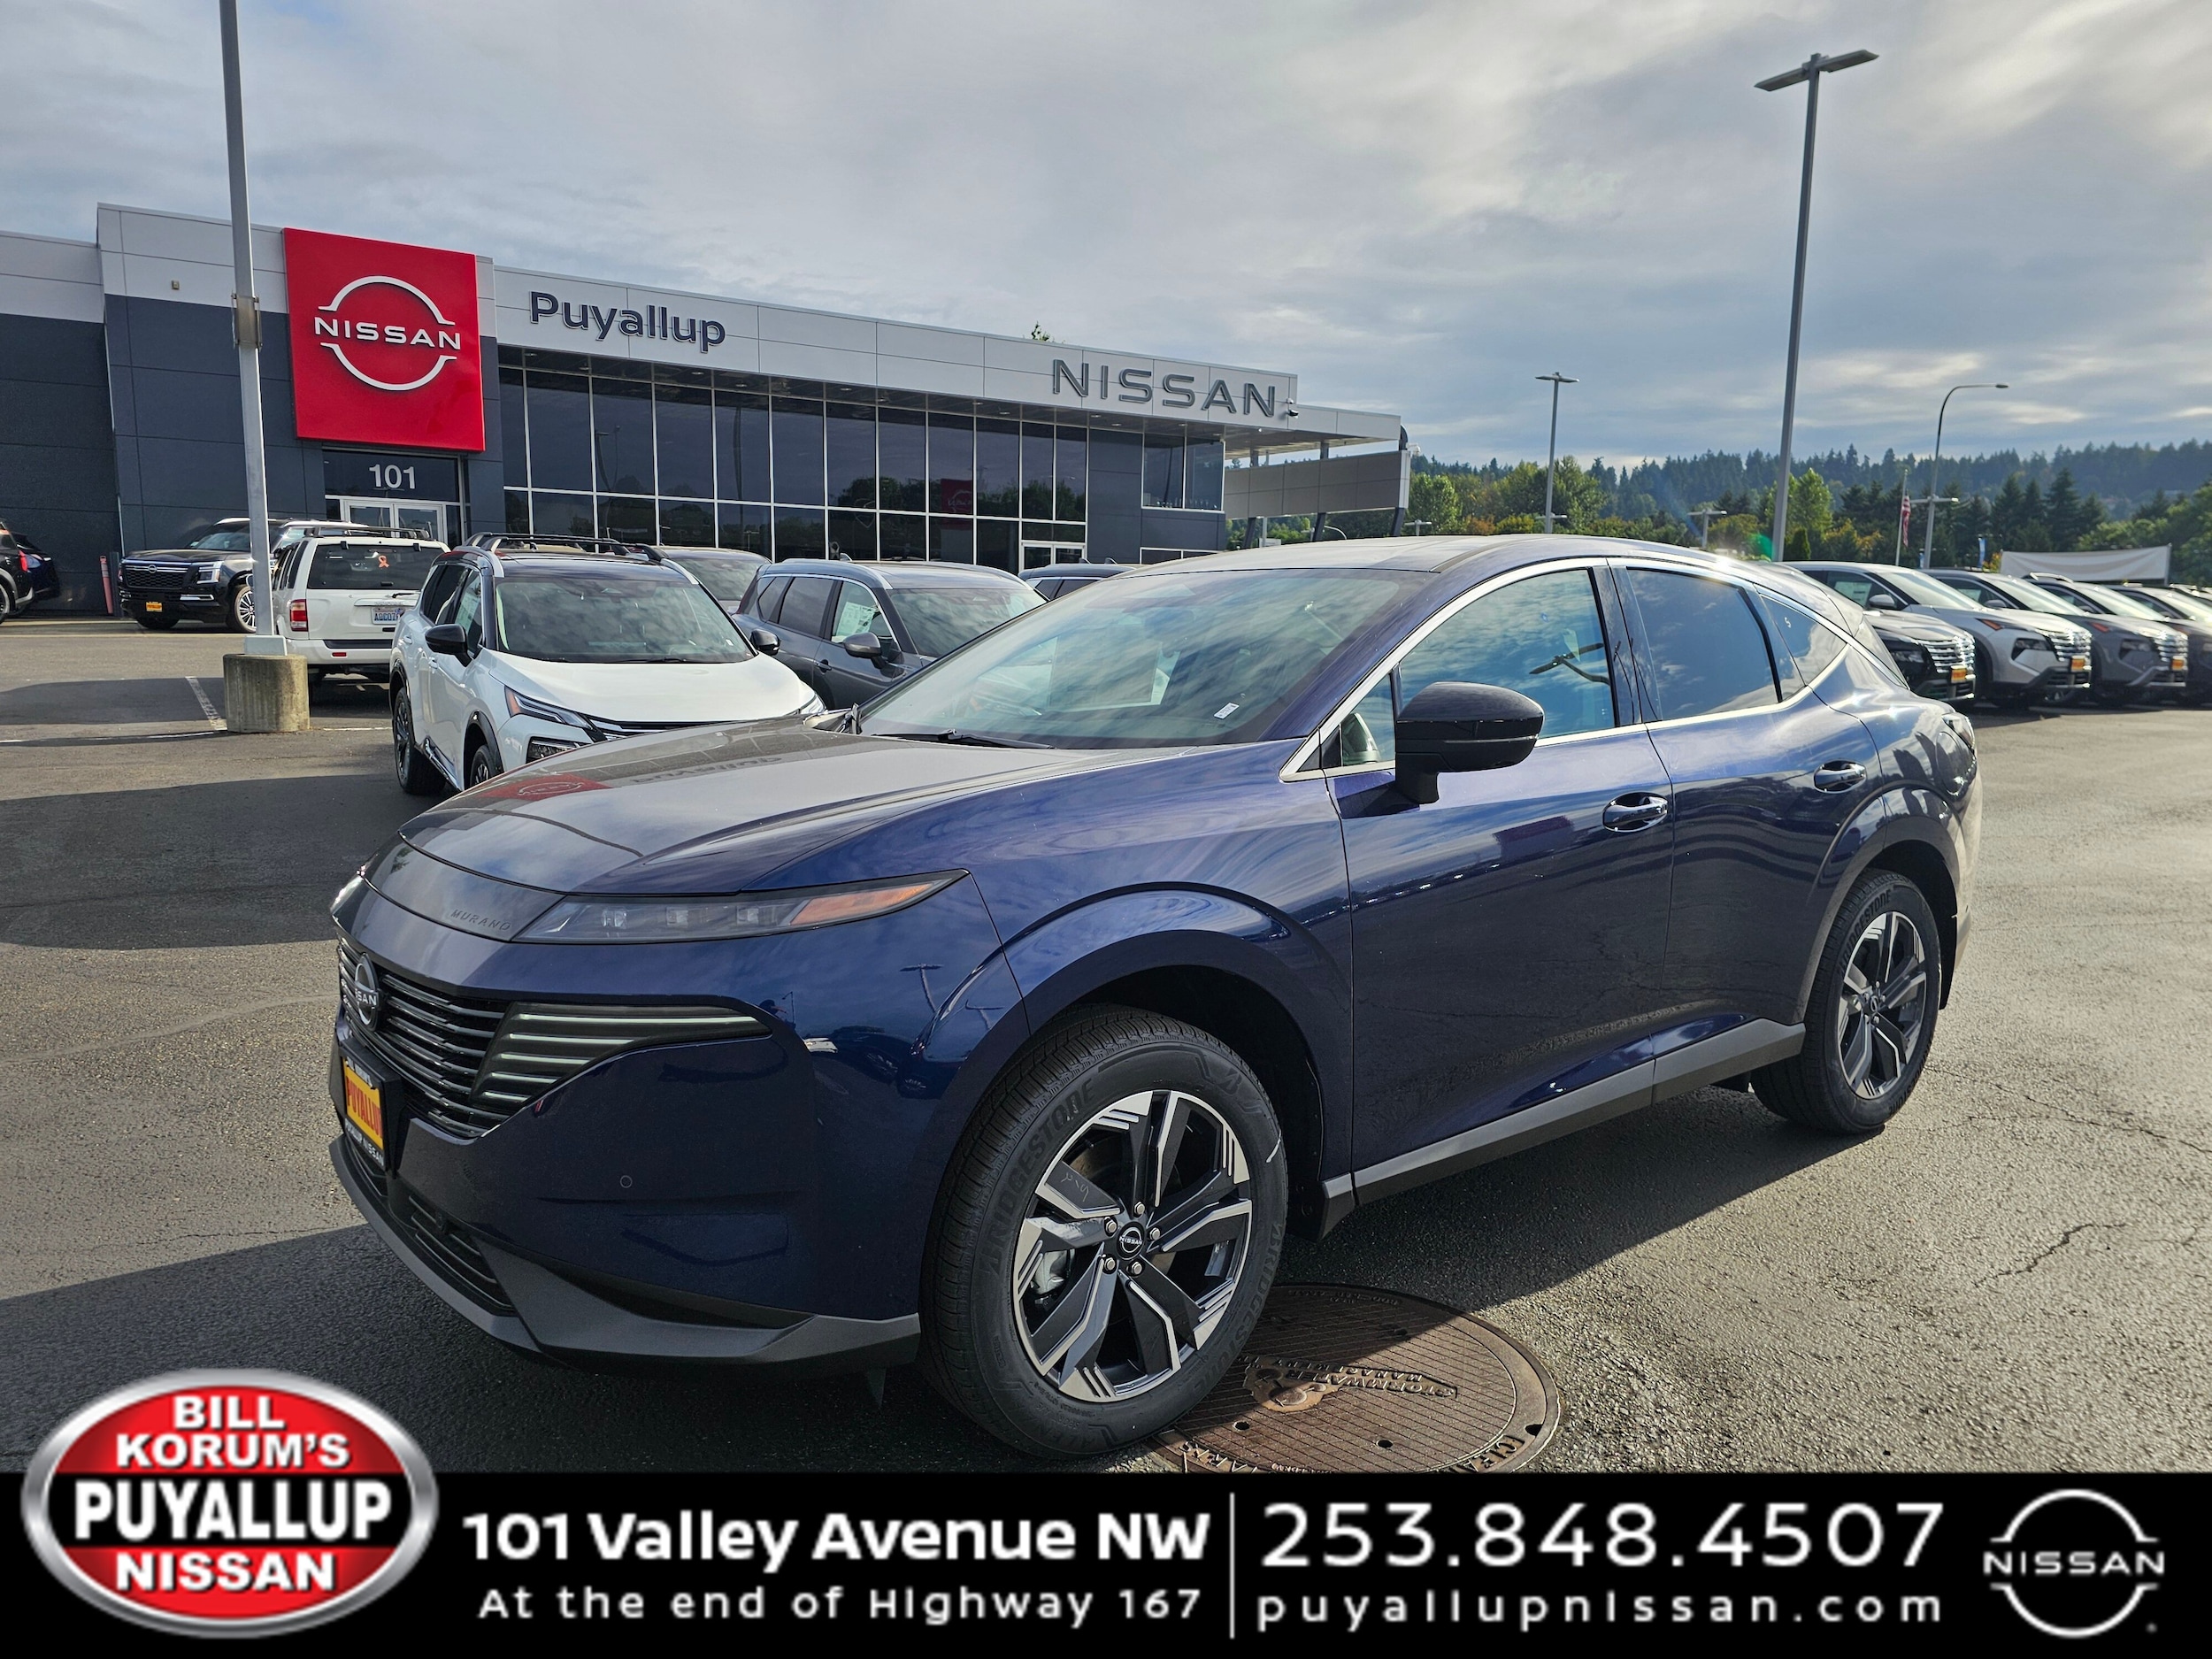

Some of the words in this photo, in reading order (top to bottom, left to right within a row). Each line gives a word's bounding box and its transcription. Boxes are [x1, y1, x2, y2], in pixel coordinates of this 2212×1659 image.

[314, 317, 461, 350] NISSAN
[529, 290, 726, 353] Puyallup
[1052, 358, 1276, 418] NISSAN
[369, 464, 415, 489] 101
[450, 909, 511, 931] MURANO
[1119, 1236, 1143, 1246] NISSAN
